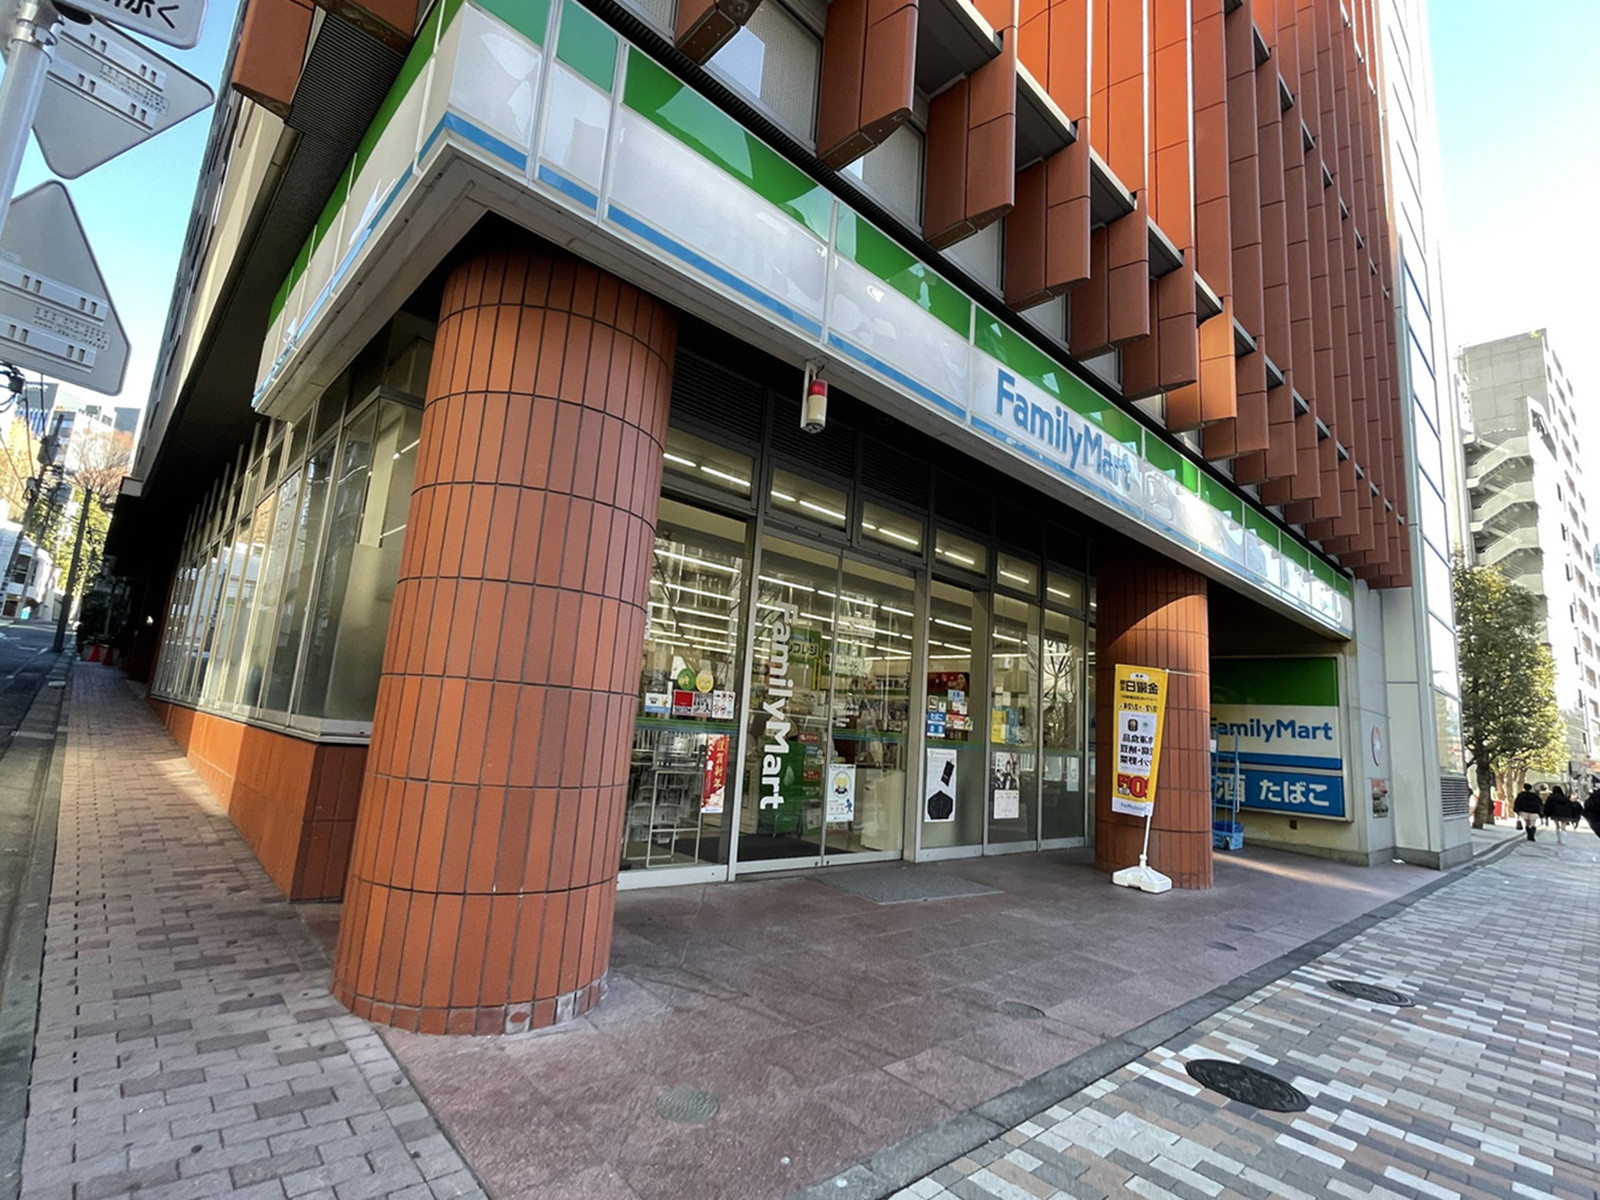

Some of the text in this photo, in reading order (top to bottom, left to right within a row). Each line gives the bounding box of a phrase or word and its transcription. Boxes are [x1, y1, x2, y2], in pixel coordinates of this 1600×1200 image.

[996, 367, 1132, 492] FamilyMart
[760, 601, 799, 810] FamilyMart
[1260, 779, 1330, 806] たばこ
